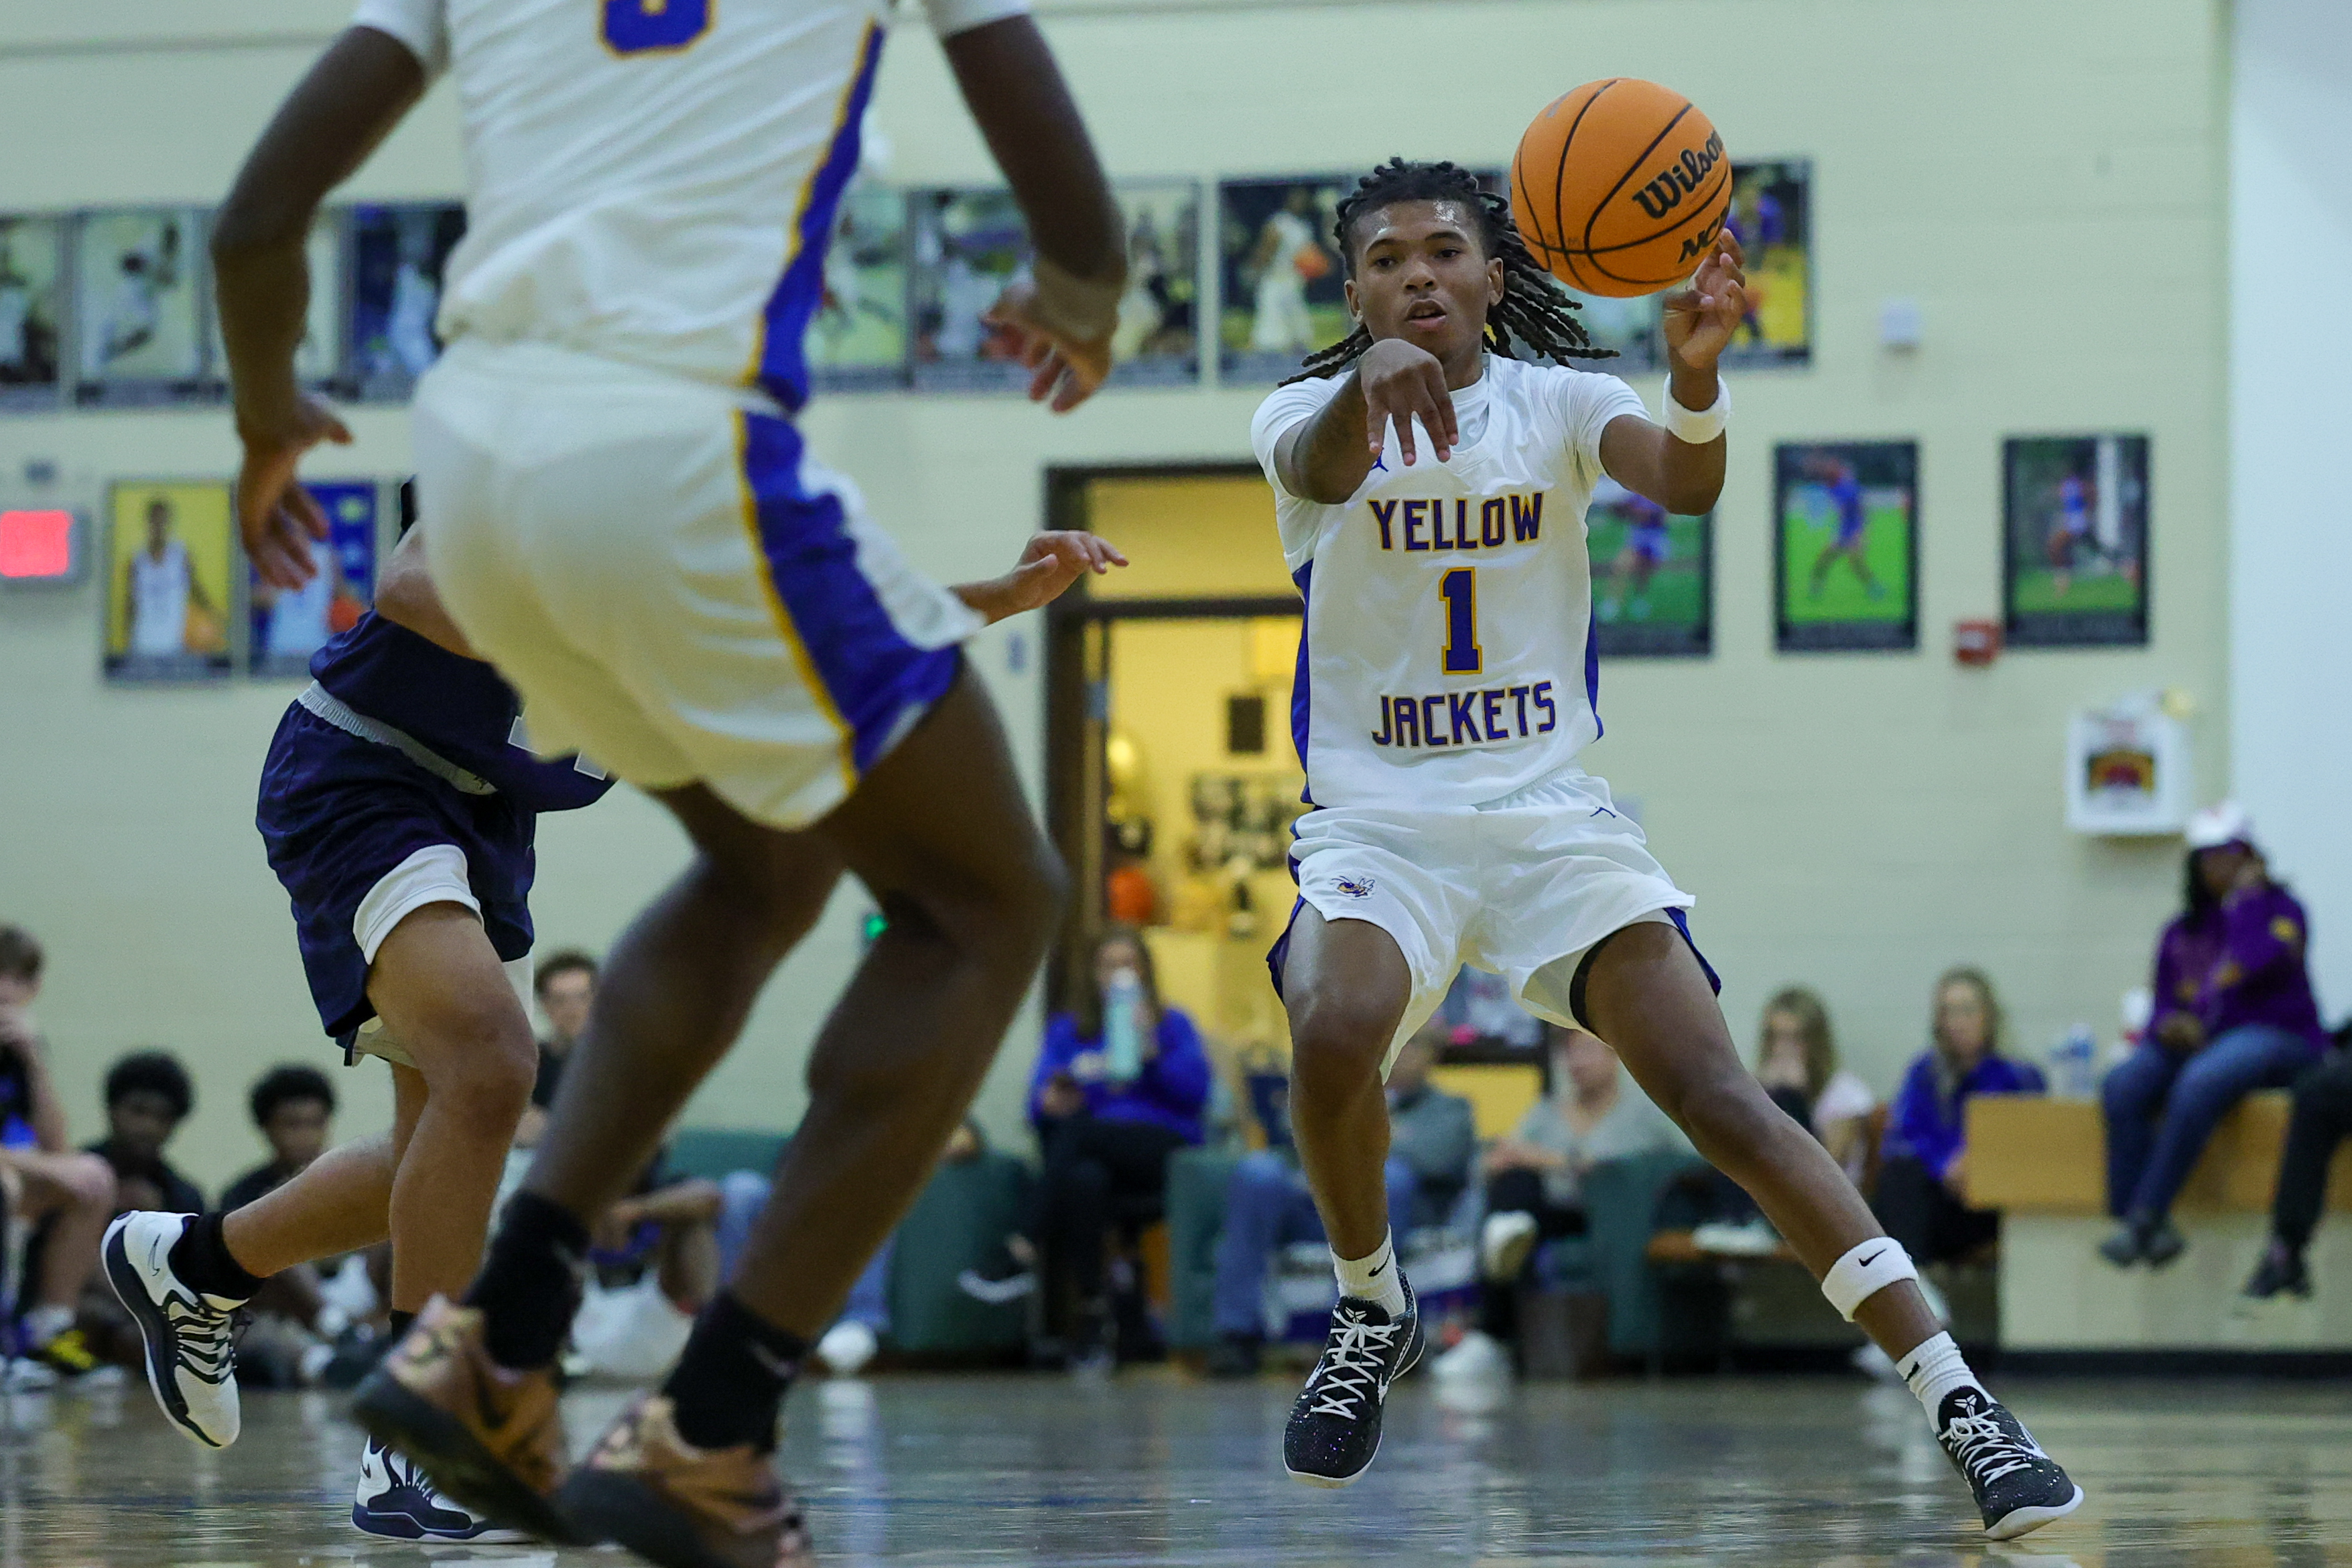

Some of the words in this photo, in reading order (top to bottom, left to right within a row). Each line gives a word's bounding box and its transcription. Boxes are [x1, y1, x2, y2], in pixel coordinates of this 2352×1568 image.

[1367, 491, 1544, 551] YELLOW
[1439, 566, 1482, 675] 1
[1371, 680, 1556, 748] JACKETS
